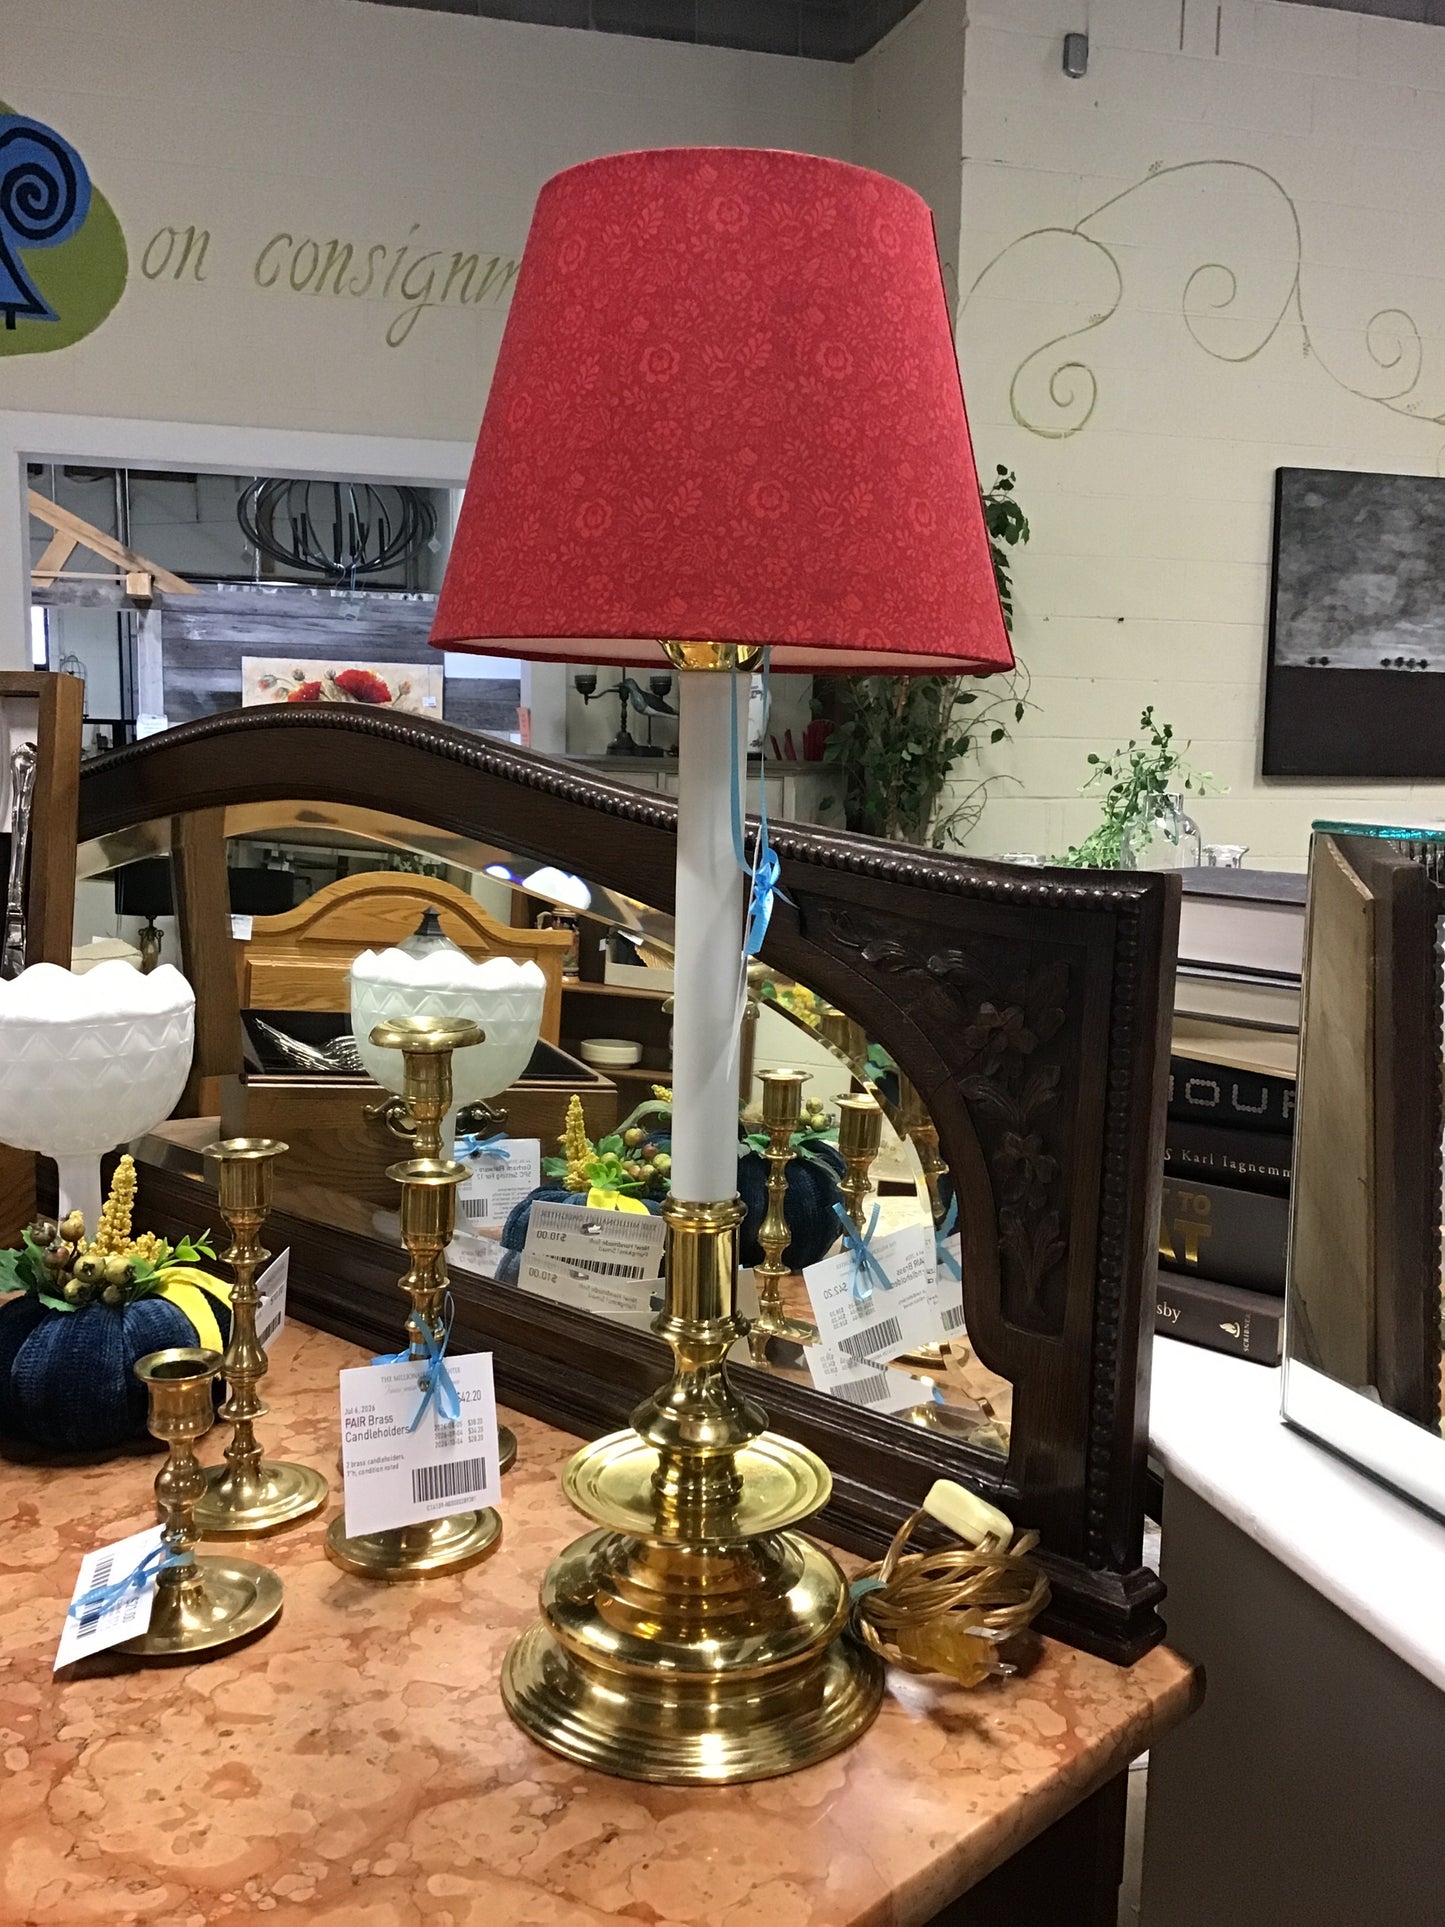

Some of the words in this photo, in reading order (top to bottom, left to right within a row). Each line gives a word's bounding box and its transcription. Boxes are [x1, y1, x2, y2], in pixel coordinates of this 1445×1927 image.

[140, 225, 211, 282] on
[253, 223, 521, 348] consignm
[1168, 1074, 1295, 1118] OU
[1182, 1149, 1214, 1165] Karl
[1223, 1155, 1292, 1178] Iagnemm
[1178, 1190, 1211, 1216] TO
[1156, 1301, 1181, 1324] sby
[345, 1416, 366, 1429] PAIR
[368, 1414, 394, 1426] Brass
[345, 1425, 410, 1443] Candleholders
